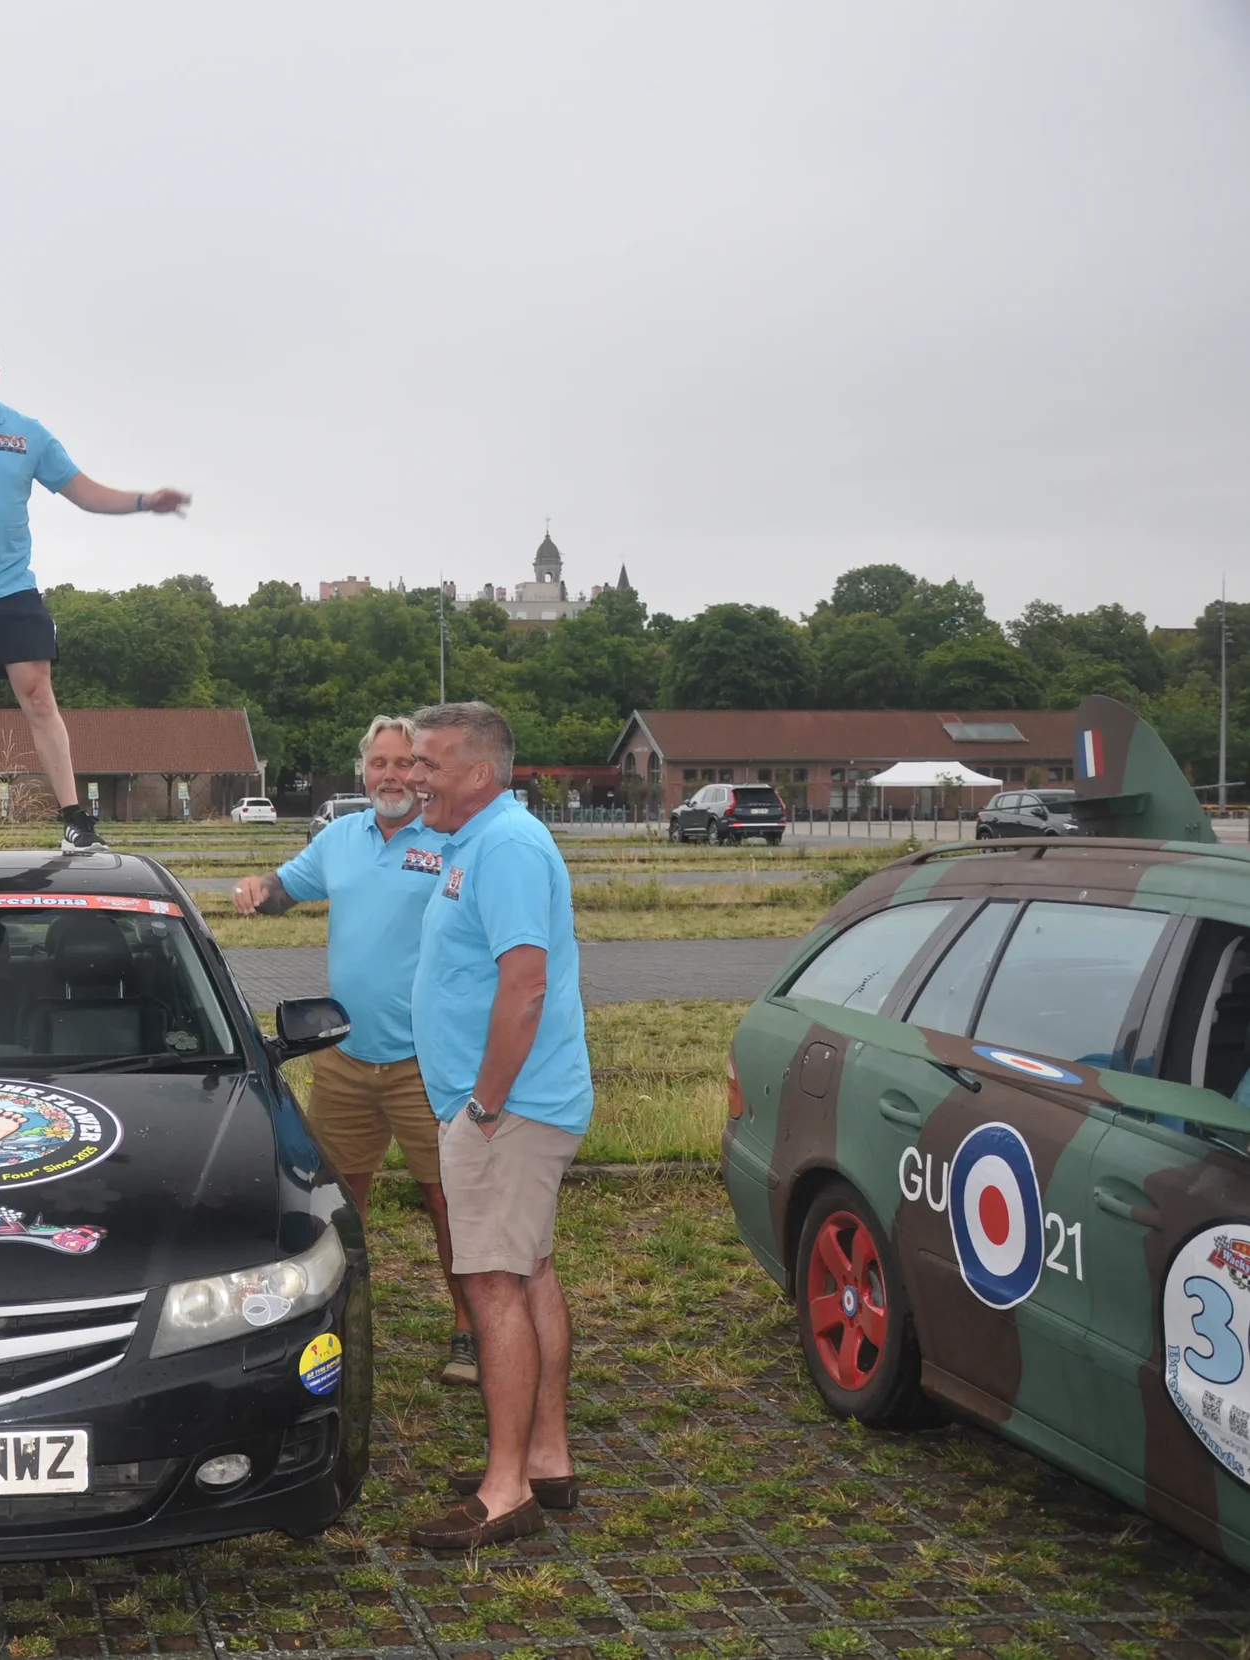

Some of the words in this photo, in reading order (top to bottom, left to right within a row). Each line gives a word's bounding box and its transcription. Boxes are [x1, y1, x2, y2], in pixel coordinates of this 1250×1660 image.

[41, 1094, 102, 1142] FLOWER
[43, 1159, 77, 1173] Since
[73, 1145, 99, 1161] 2025
[899, 1146, 949, 1212] GU
[1045, 1212, 1083, 1281] 21
[1183, 1275, 1250, 1385] 3
[1168, 1344, 1245, 1477] Brooklands
